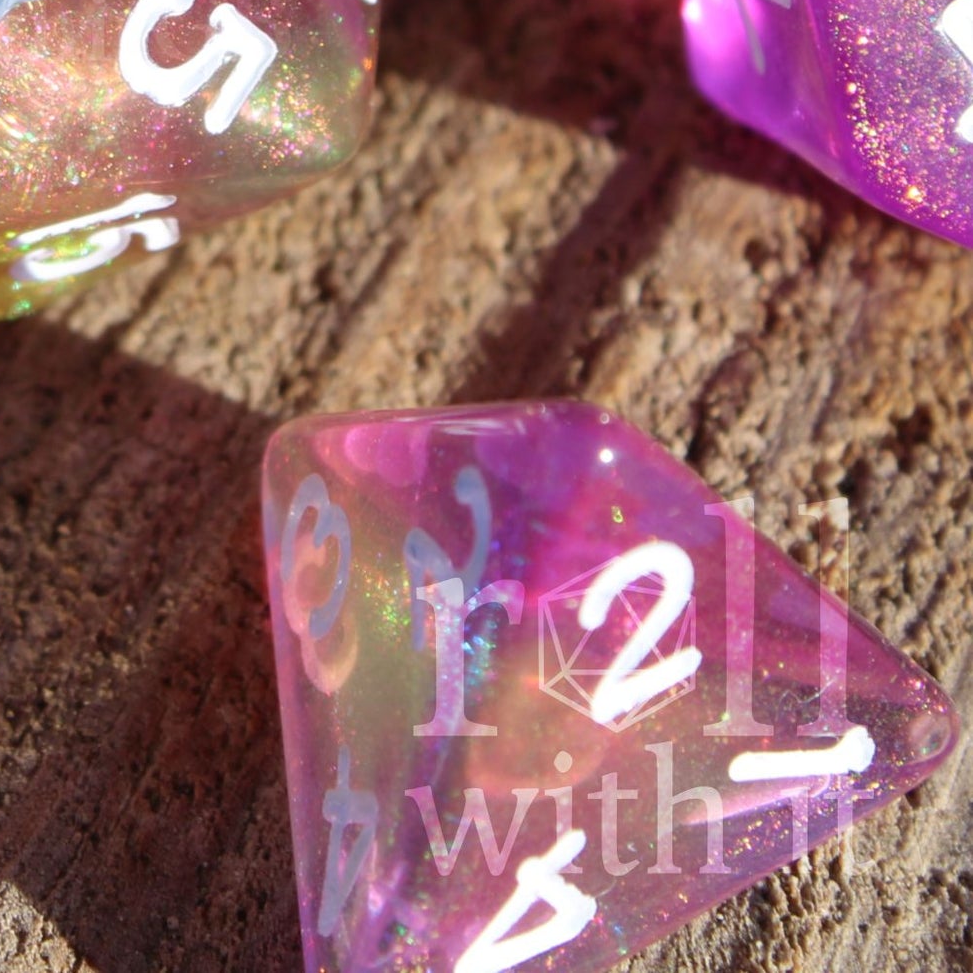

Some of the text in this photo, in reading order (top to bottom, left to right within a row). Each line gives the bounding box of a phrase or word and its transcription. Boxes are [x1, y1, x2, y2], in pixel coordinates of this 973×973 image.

[578, 540, 704, 724] 2
[728, 725, 876, 784] 1
[453, 829, 598, 973] 4
